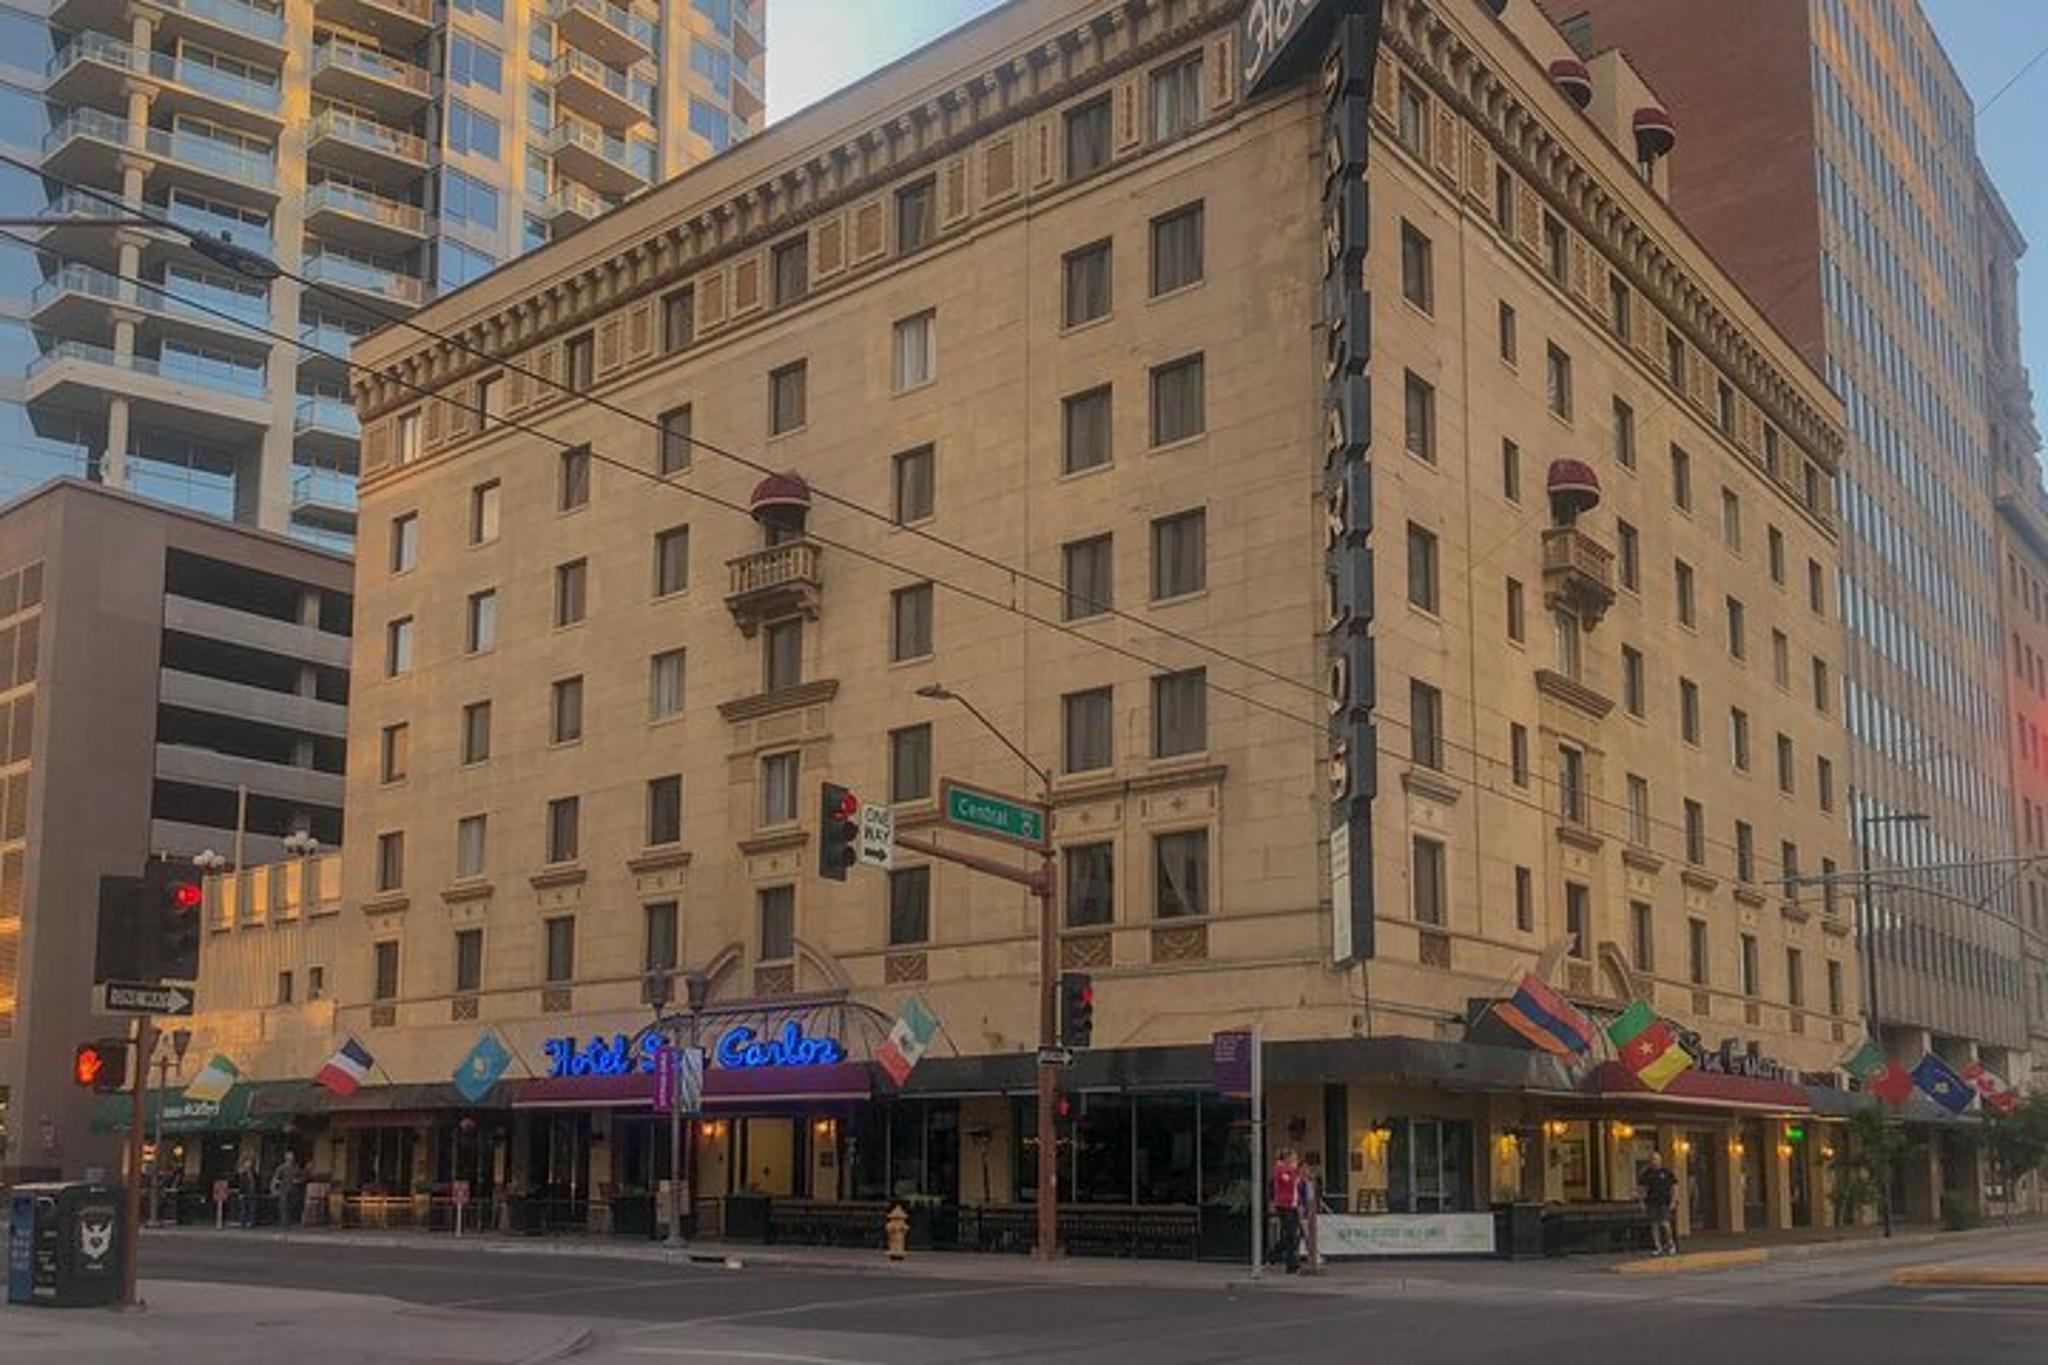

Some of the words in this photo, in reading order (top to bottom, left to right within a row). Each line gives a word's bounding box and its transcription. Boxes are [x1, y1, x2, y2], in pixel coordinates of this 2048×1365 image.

[864, 807, 890, 827] ONE
[958, 797, 1009, 828] Central
[864, 825, 890, 843] WAY
[546, 1033, 636, 1076] Hotel
[716, 1018, 845, 1069] Carlos
